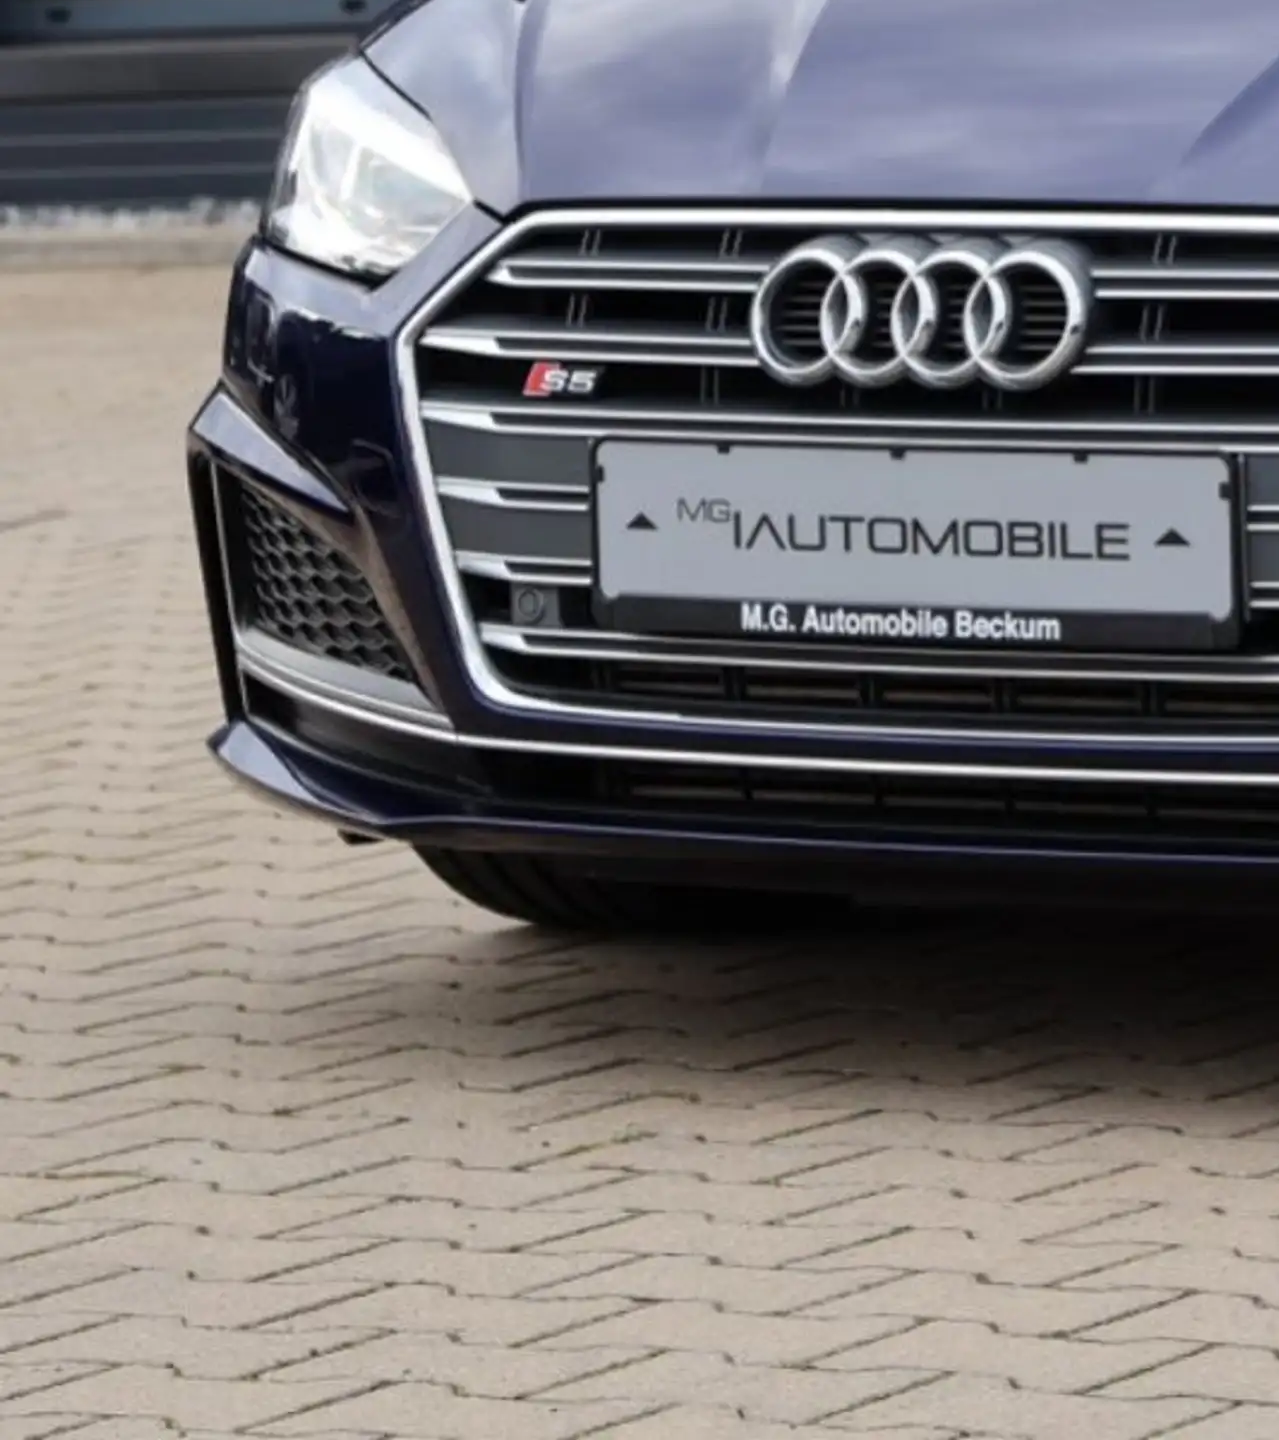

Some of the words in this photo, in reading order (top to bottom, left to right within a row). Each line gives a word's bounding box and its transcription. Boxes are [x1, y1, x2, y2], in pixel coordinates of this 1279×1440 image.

[677, 497, 731, 523] MG
[740, 602, 797, 633] M.G.
[802, 606, 947, 639] Automobile
[954, 611, 1061, 641] Beckum
